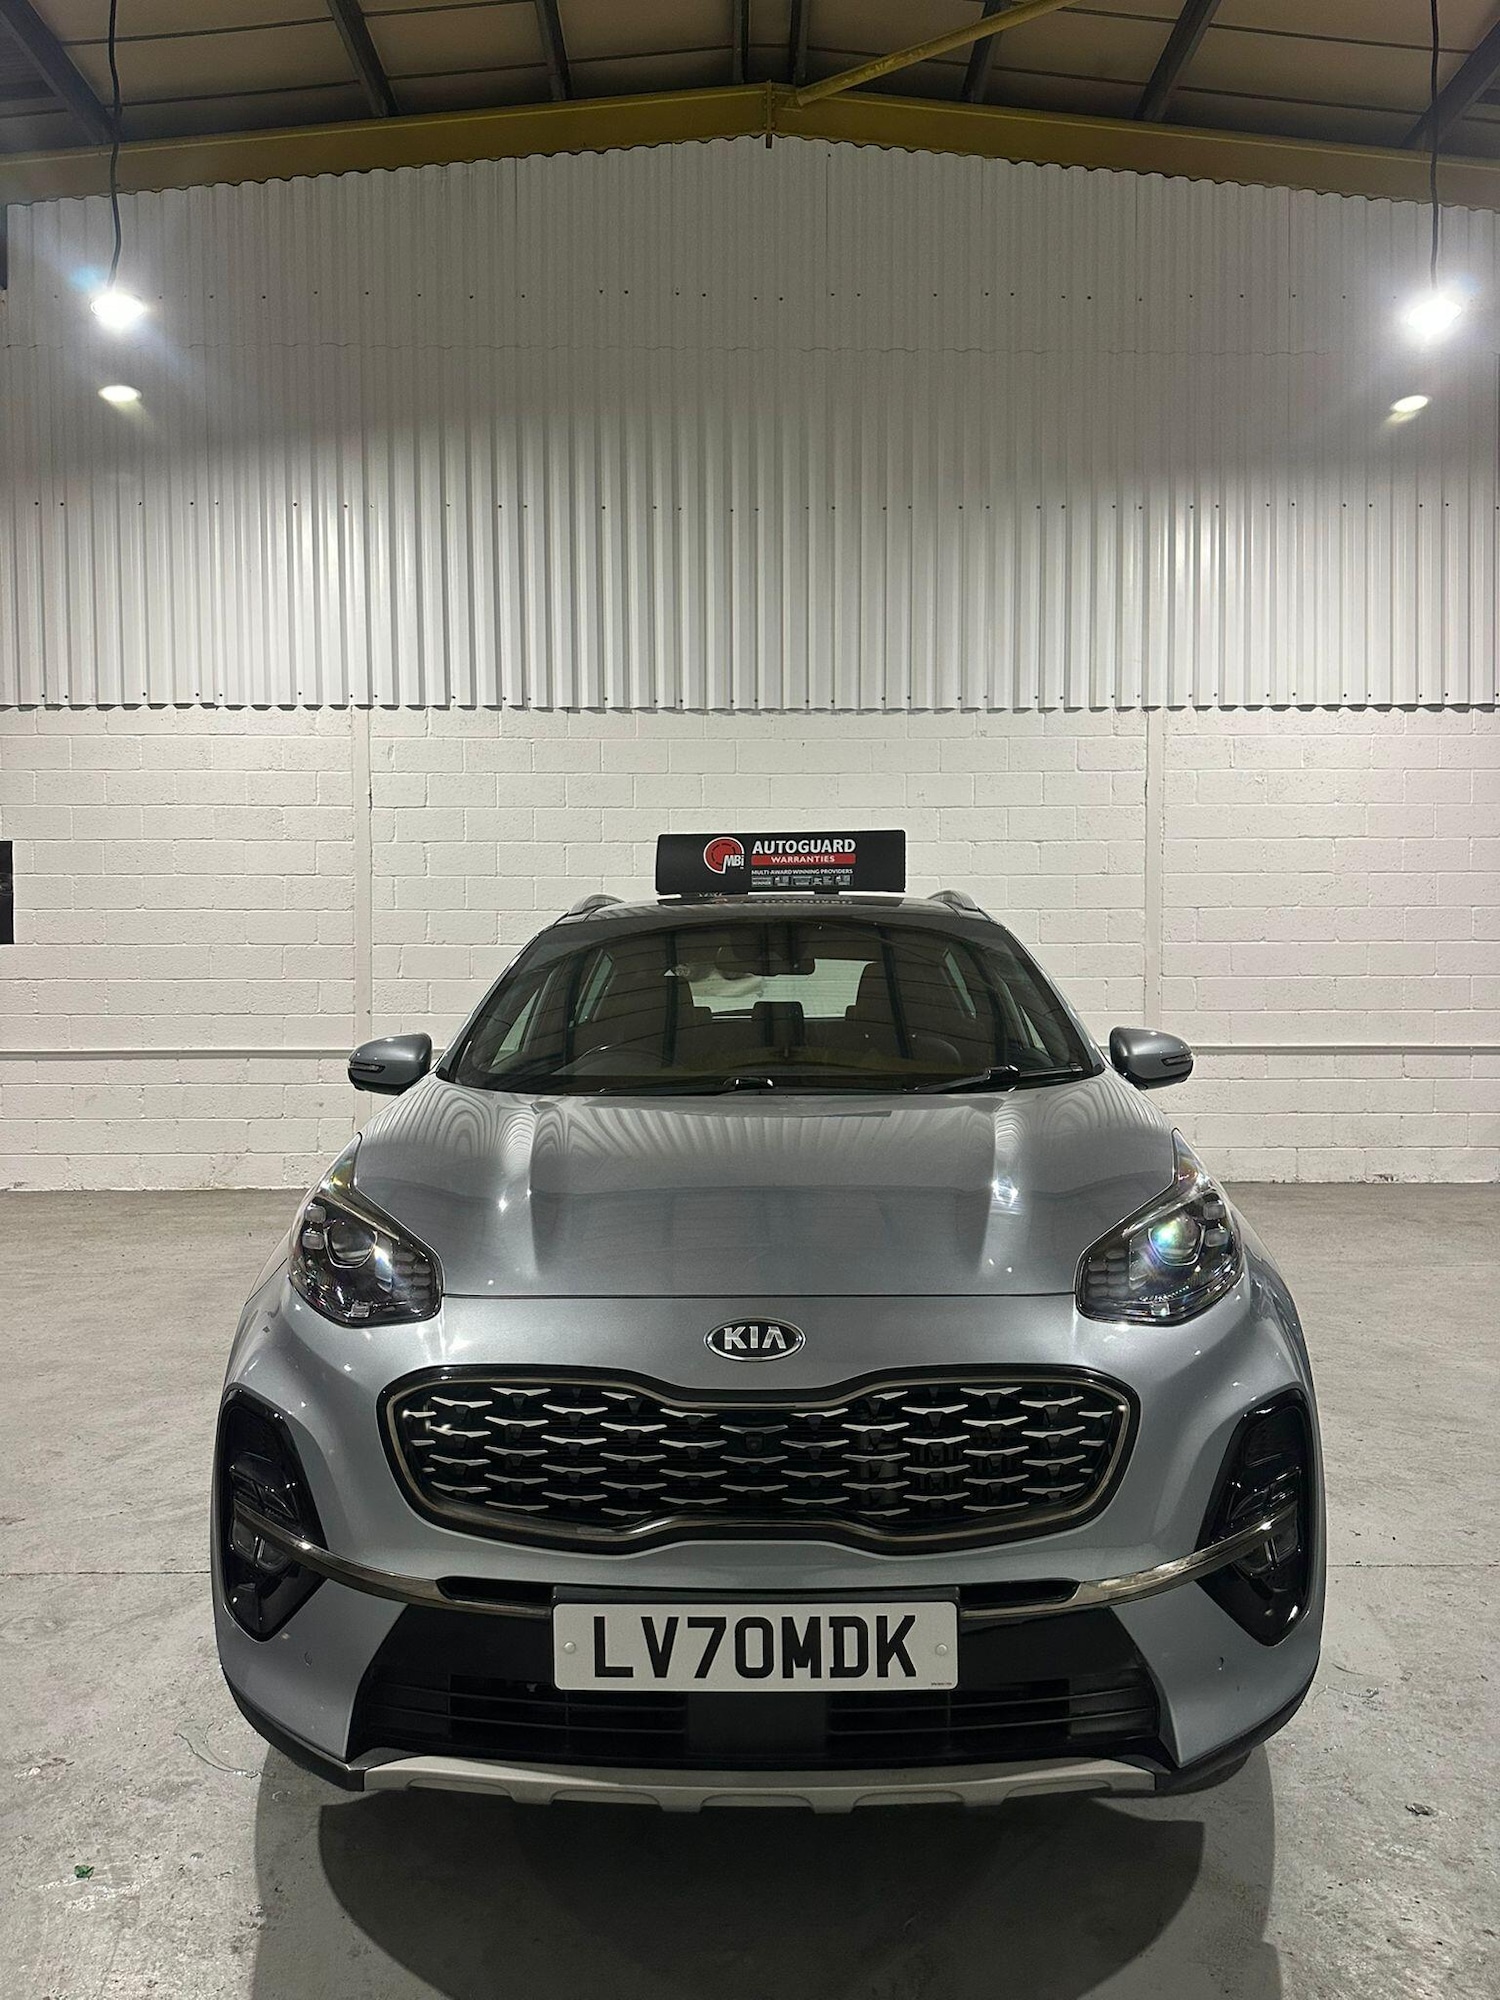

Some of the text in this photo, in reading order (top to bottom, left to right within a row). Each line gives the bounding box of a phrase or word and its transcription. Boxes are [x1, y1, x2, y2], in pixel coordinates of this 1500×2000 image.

[752, 839, 856, 854] AUTOGUARD
[771, 855, 835, 863] WARRANTIES
[723, 1325, 787, 1350] KIA
[593, 1615, 917, 1679] LV70MDK
